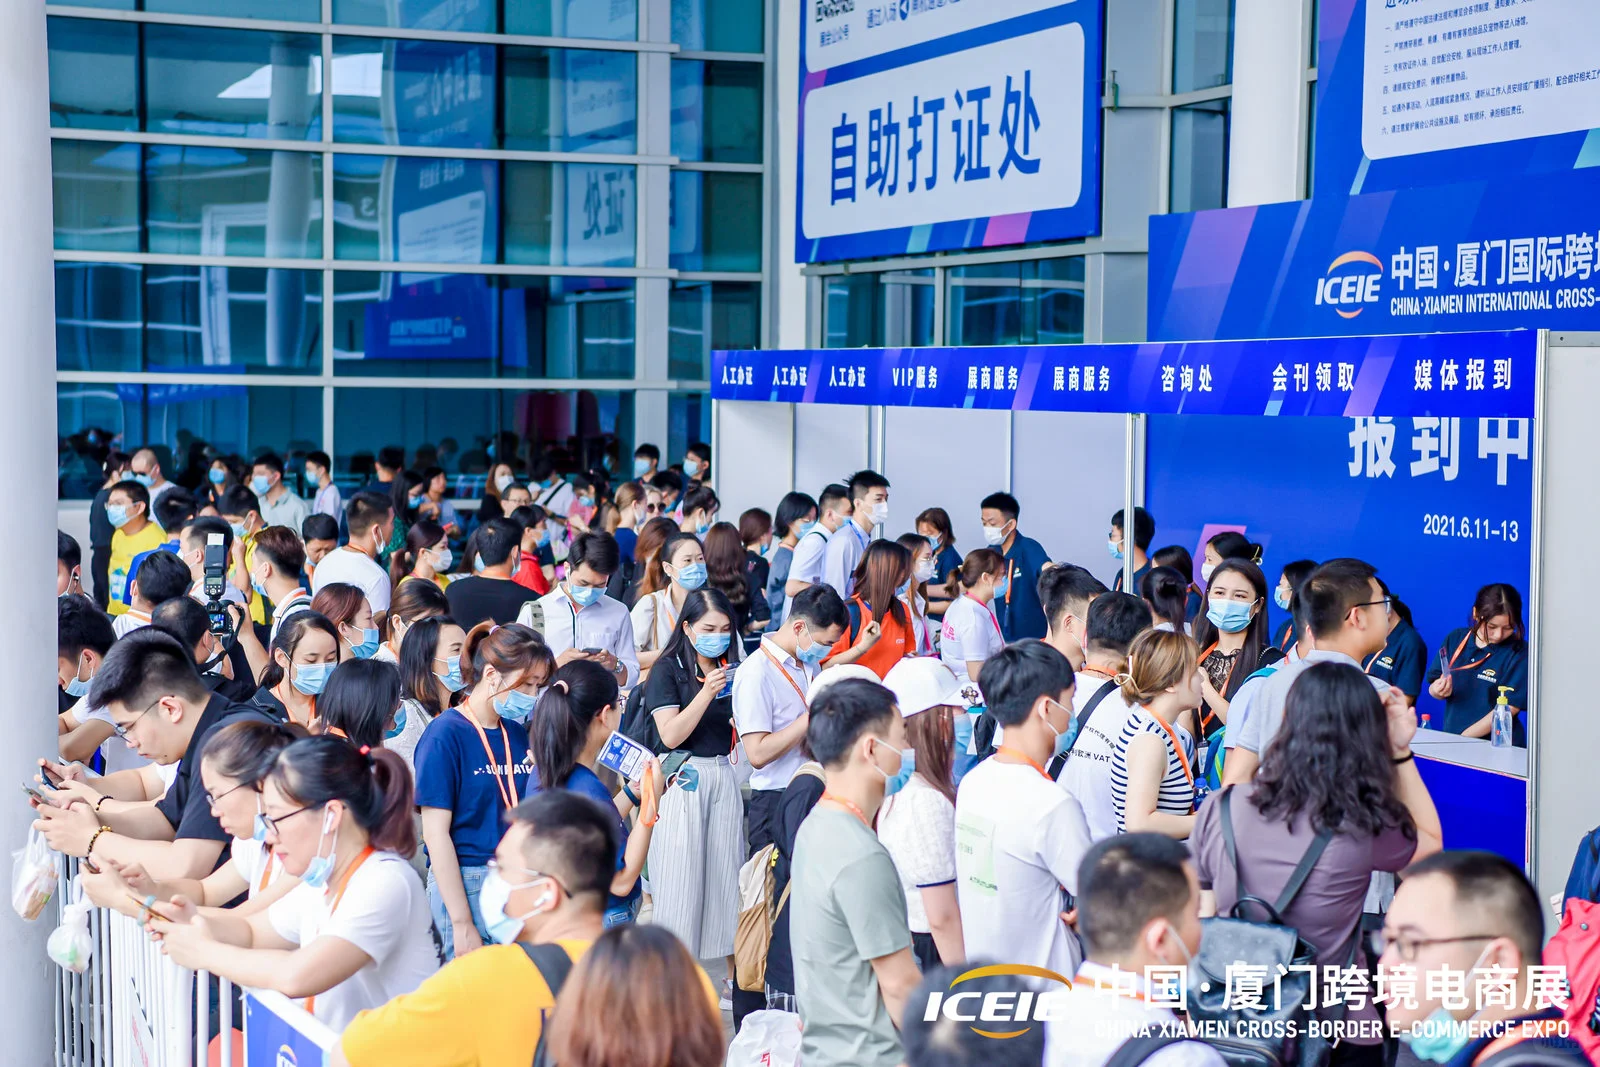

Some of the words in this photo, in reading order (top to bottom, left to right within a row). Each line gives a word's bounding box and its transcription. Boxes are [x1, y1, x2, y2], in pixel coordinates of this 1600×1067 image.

[831, 69, 1041, 206] 自助打证处
[1315, 273, 1382, 306] ICEIE
[1390, 294, 1463, 316] CHINA·XIAMEN
[1466, 290, 1553, 313] INTERNATIONAL
[721, 365, 753, 385] 人工办证
[772, 365, 807, 386] 人工办证
[829, 366, 866, 387] 人工办证
[892, 366, 938, 389] VIP服务
[967, 365, 1018, 390] 展商服务
[1053, 366, 1110, 391] 展商服务
[1161, 364, 1213, 392] 咨询处
[1272, 361, 1355, 392] 会刊领取
[1414, 357, 1512, 391] 媒体报到
[1423, 513, 1519, 542] 2021.6.11-13
[1093, 753, 1111, 763] VAT
